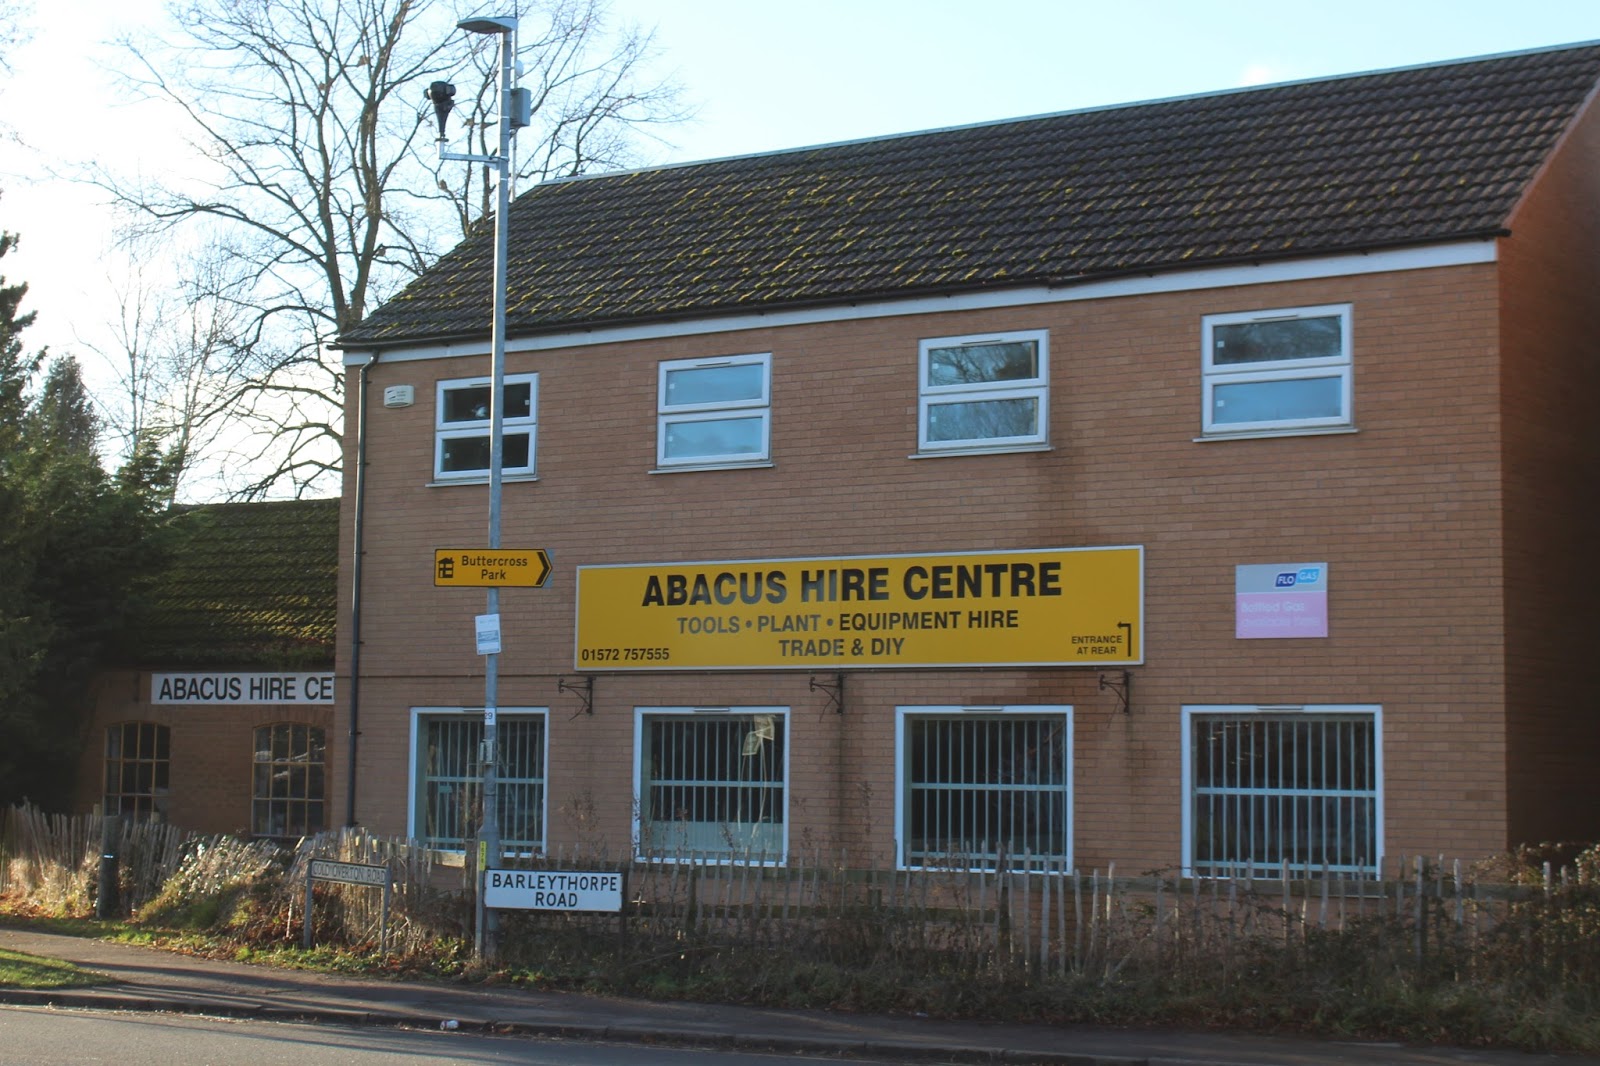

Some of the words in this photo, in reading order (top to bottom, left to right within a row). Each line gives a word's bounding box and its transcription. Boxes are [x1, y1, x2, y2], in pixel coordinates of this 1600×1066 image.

[461, 555, 528, 566] Buttercross
[481, 569, 506, 579] Park
[1278, 576, 1295, 584] FLO
[642, 570, 787, 606] ABACUS
[801, 567, 889, 602] HIRE
[903, 562, 1062, 600] CENTRE
[677, 616, 740, 634] TOOLS
[757, 614, 821, 633] PLANT
[839, 611, 961, 631] EQUIPMENT
[968, 609, 1018, 629] HIRE
[779, 639, 844, 657] TRADE
[851, 638, 864, 656] &
[871, 637, 905, 656] DIY
[1071, 635, 1122, 645] ENTRANCE
[581, 649, 620, 661] 01572
[624, 648, 670, 660] 757555
[1076, 647, 1088, 655] AT
[1091, 646, 1117, 655] REAR
[159, 677, 241, 701] ABACUS
[250, 677, 296, 700] HIRE
[304, 677, 334, 700] CE
[367, 869, 386, 883] ROAD
[492, 873, 617, 891] BARLEYTHORPE
[535, 892, 577, 907] ROAD
